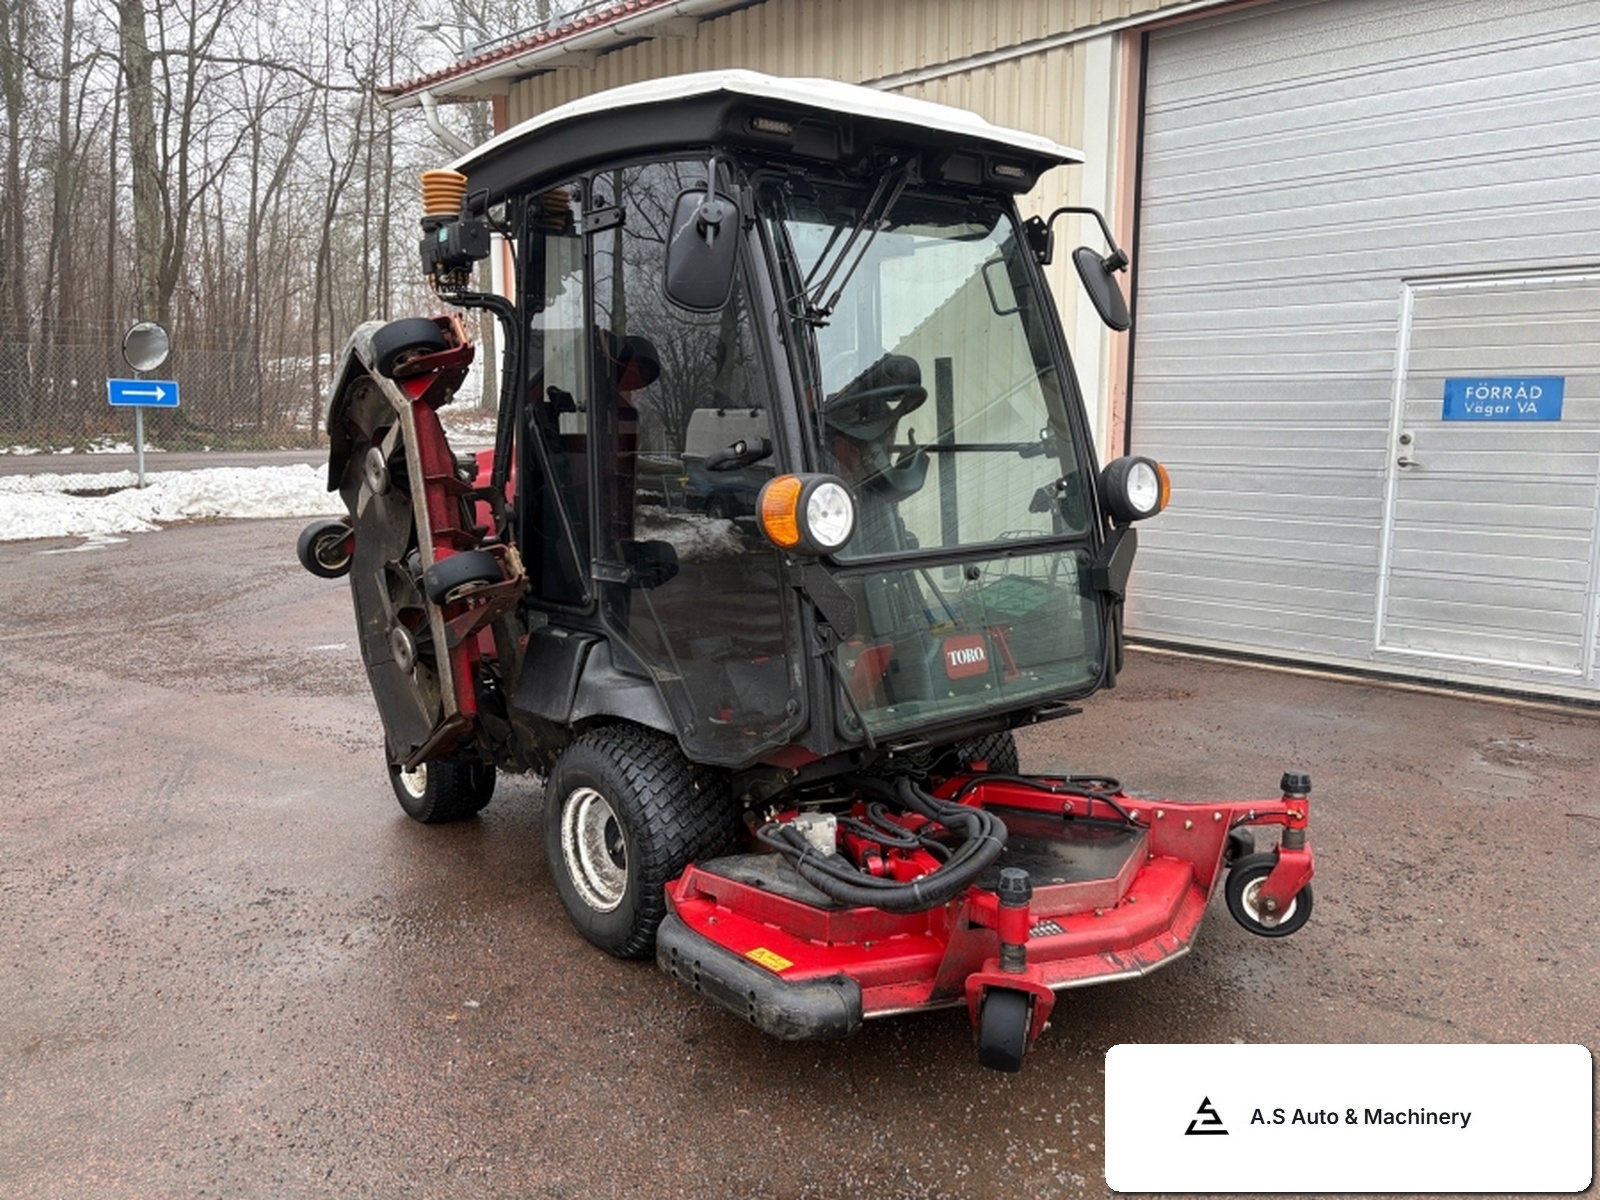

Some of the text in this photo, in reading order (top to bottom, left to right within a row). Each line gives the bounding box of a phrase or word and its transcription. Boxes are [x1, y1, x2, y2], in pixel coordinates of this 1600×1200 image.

[1465, 382, 1543, 399] FÖRRÅD
[1464, 402, 1538, 416] Vägar VA
[947, 646, 985, 666] TORO
